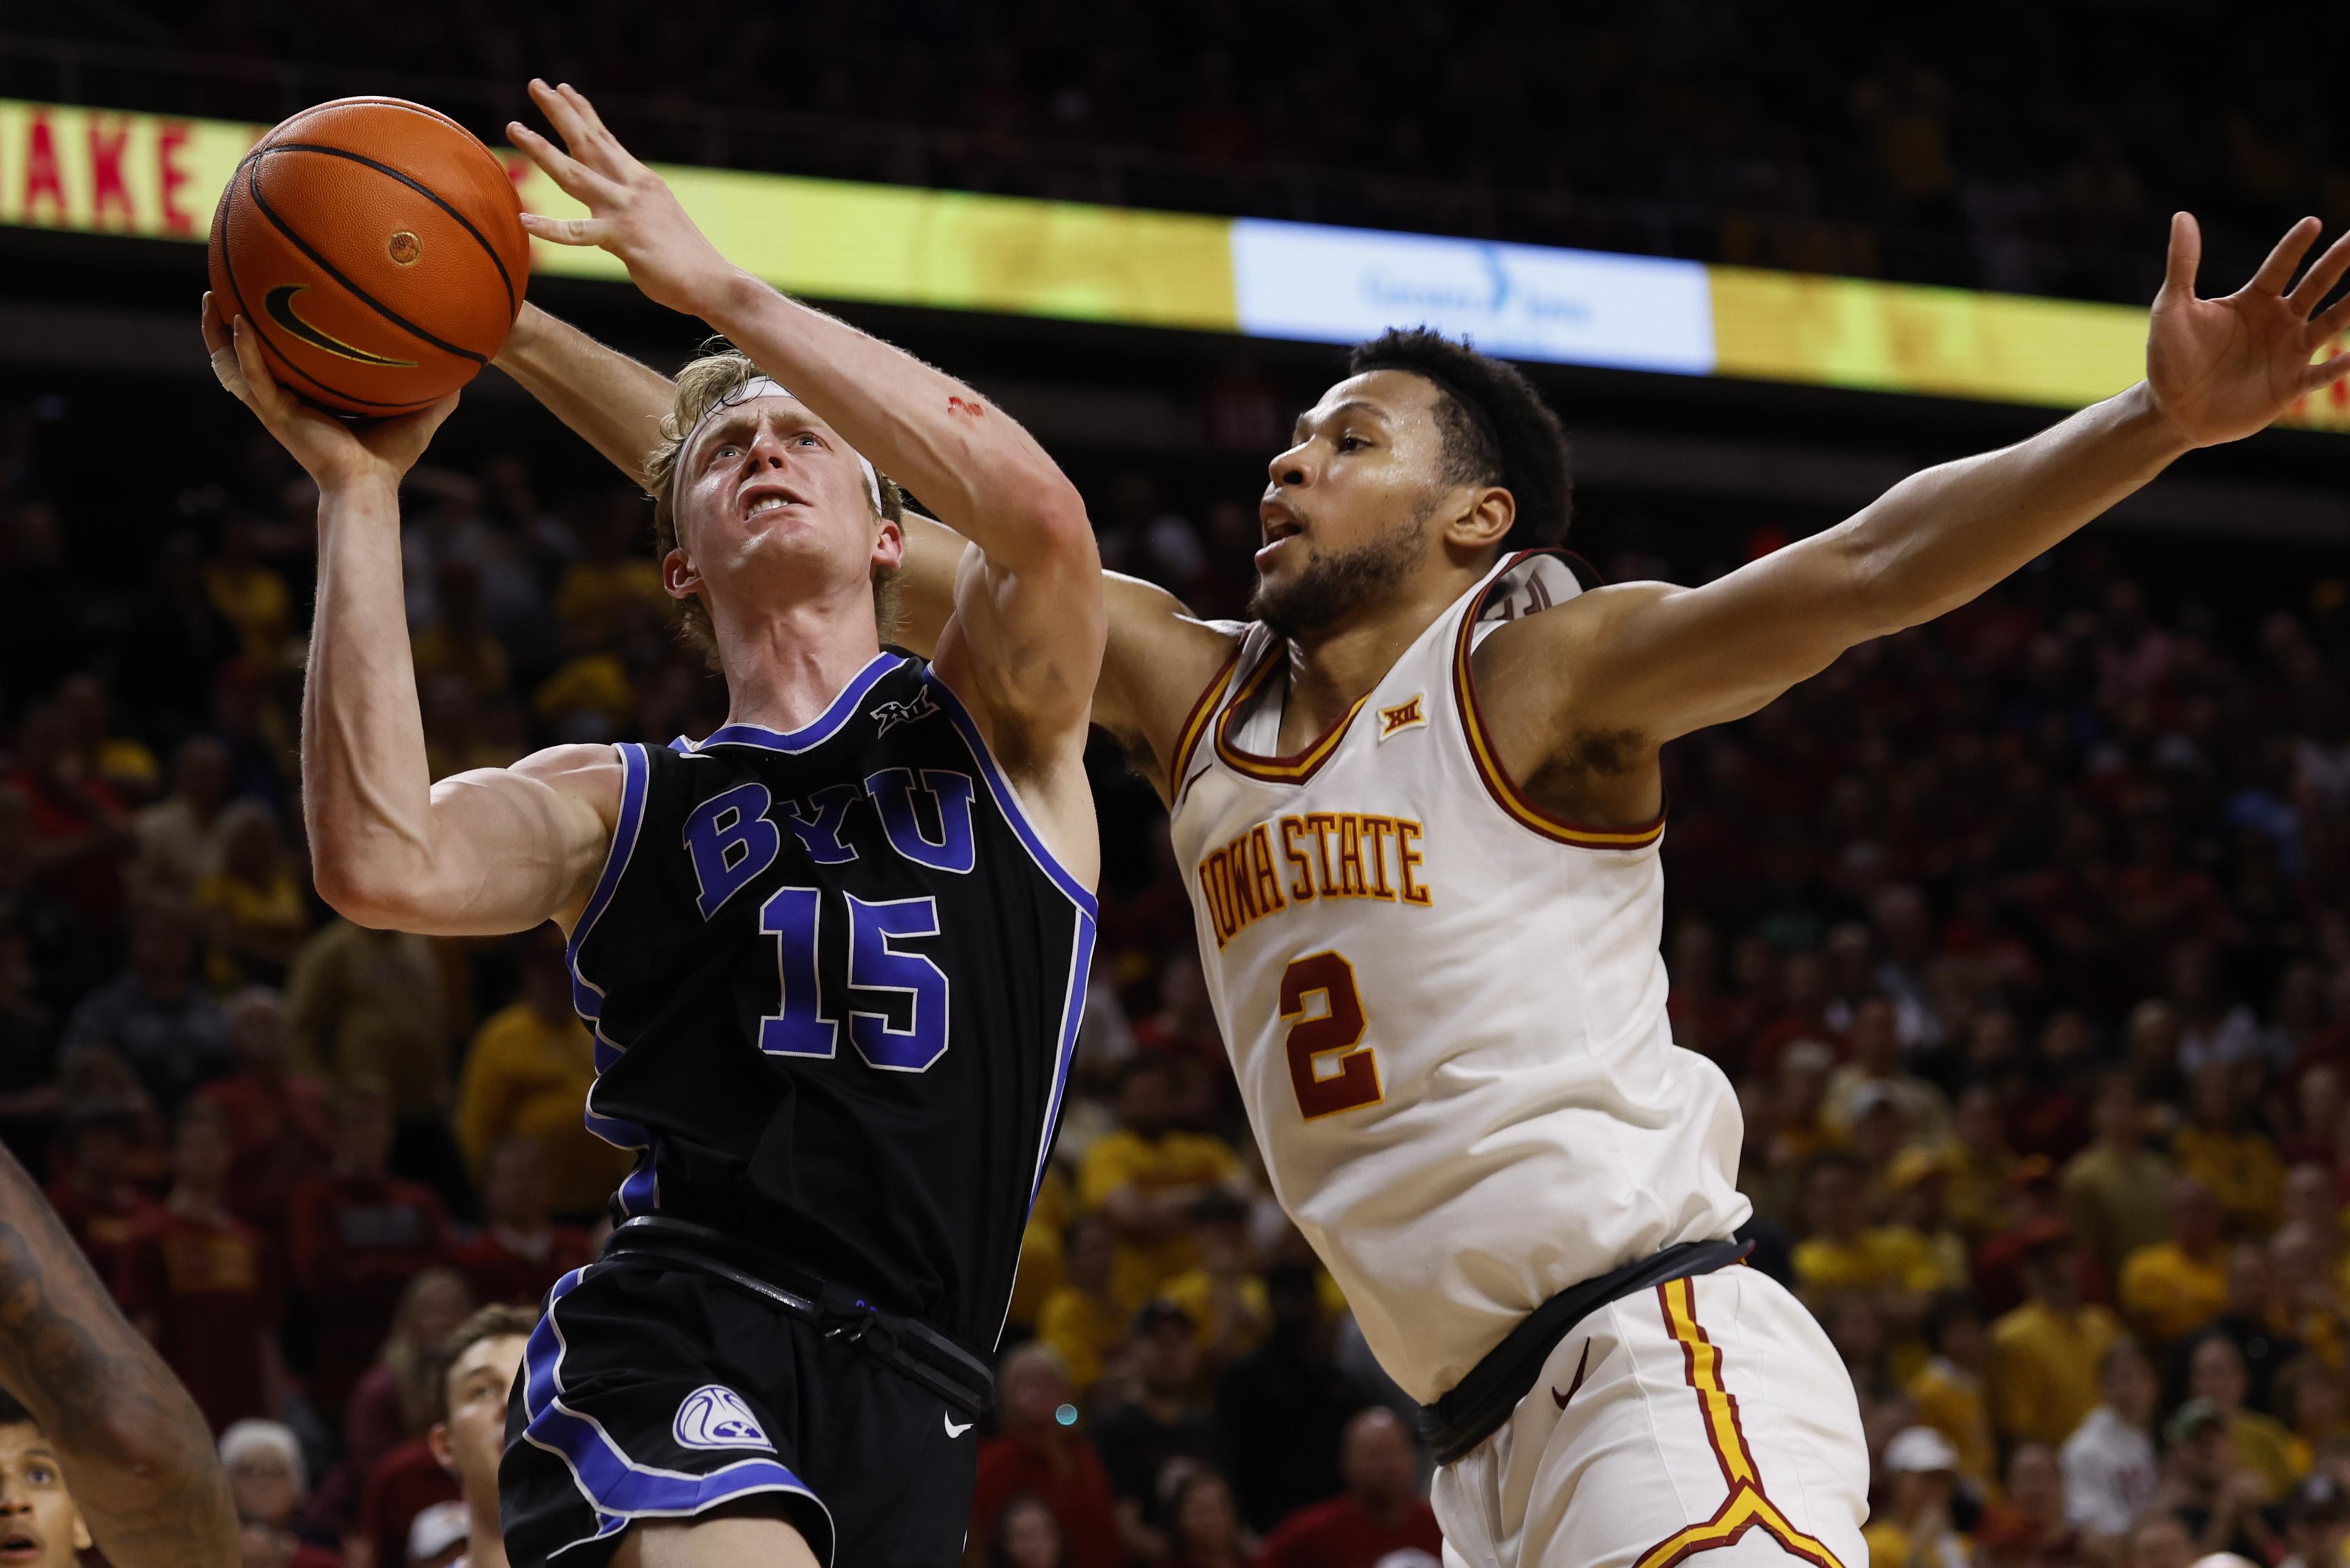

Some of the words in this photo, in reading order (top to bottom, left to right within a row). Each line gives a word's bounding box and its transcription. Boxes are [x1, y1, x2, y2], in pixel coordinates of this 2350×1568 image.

[682, 767, 976, 923] BYU
[1198, 822, 1289, 953] IOWA
[1280, 811, 1434, 908] STATE
[758, 886, 949, 1074] 15
[1279, 948, 1385, 1123] 2
